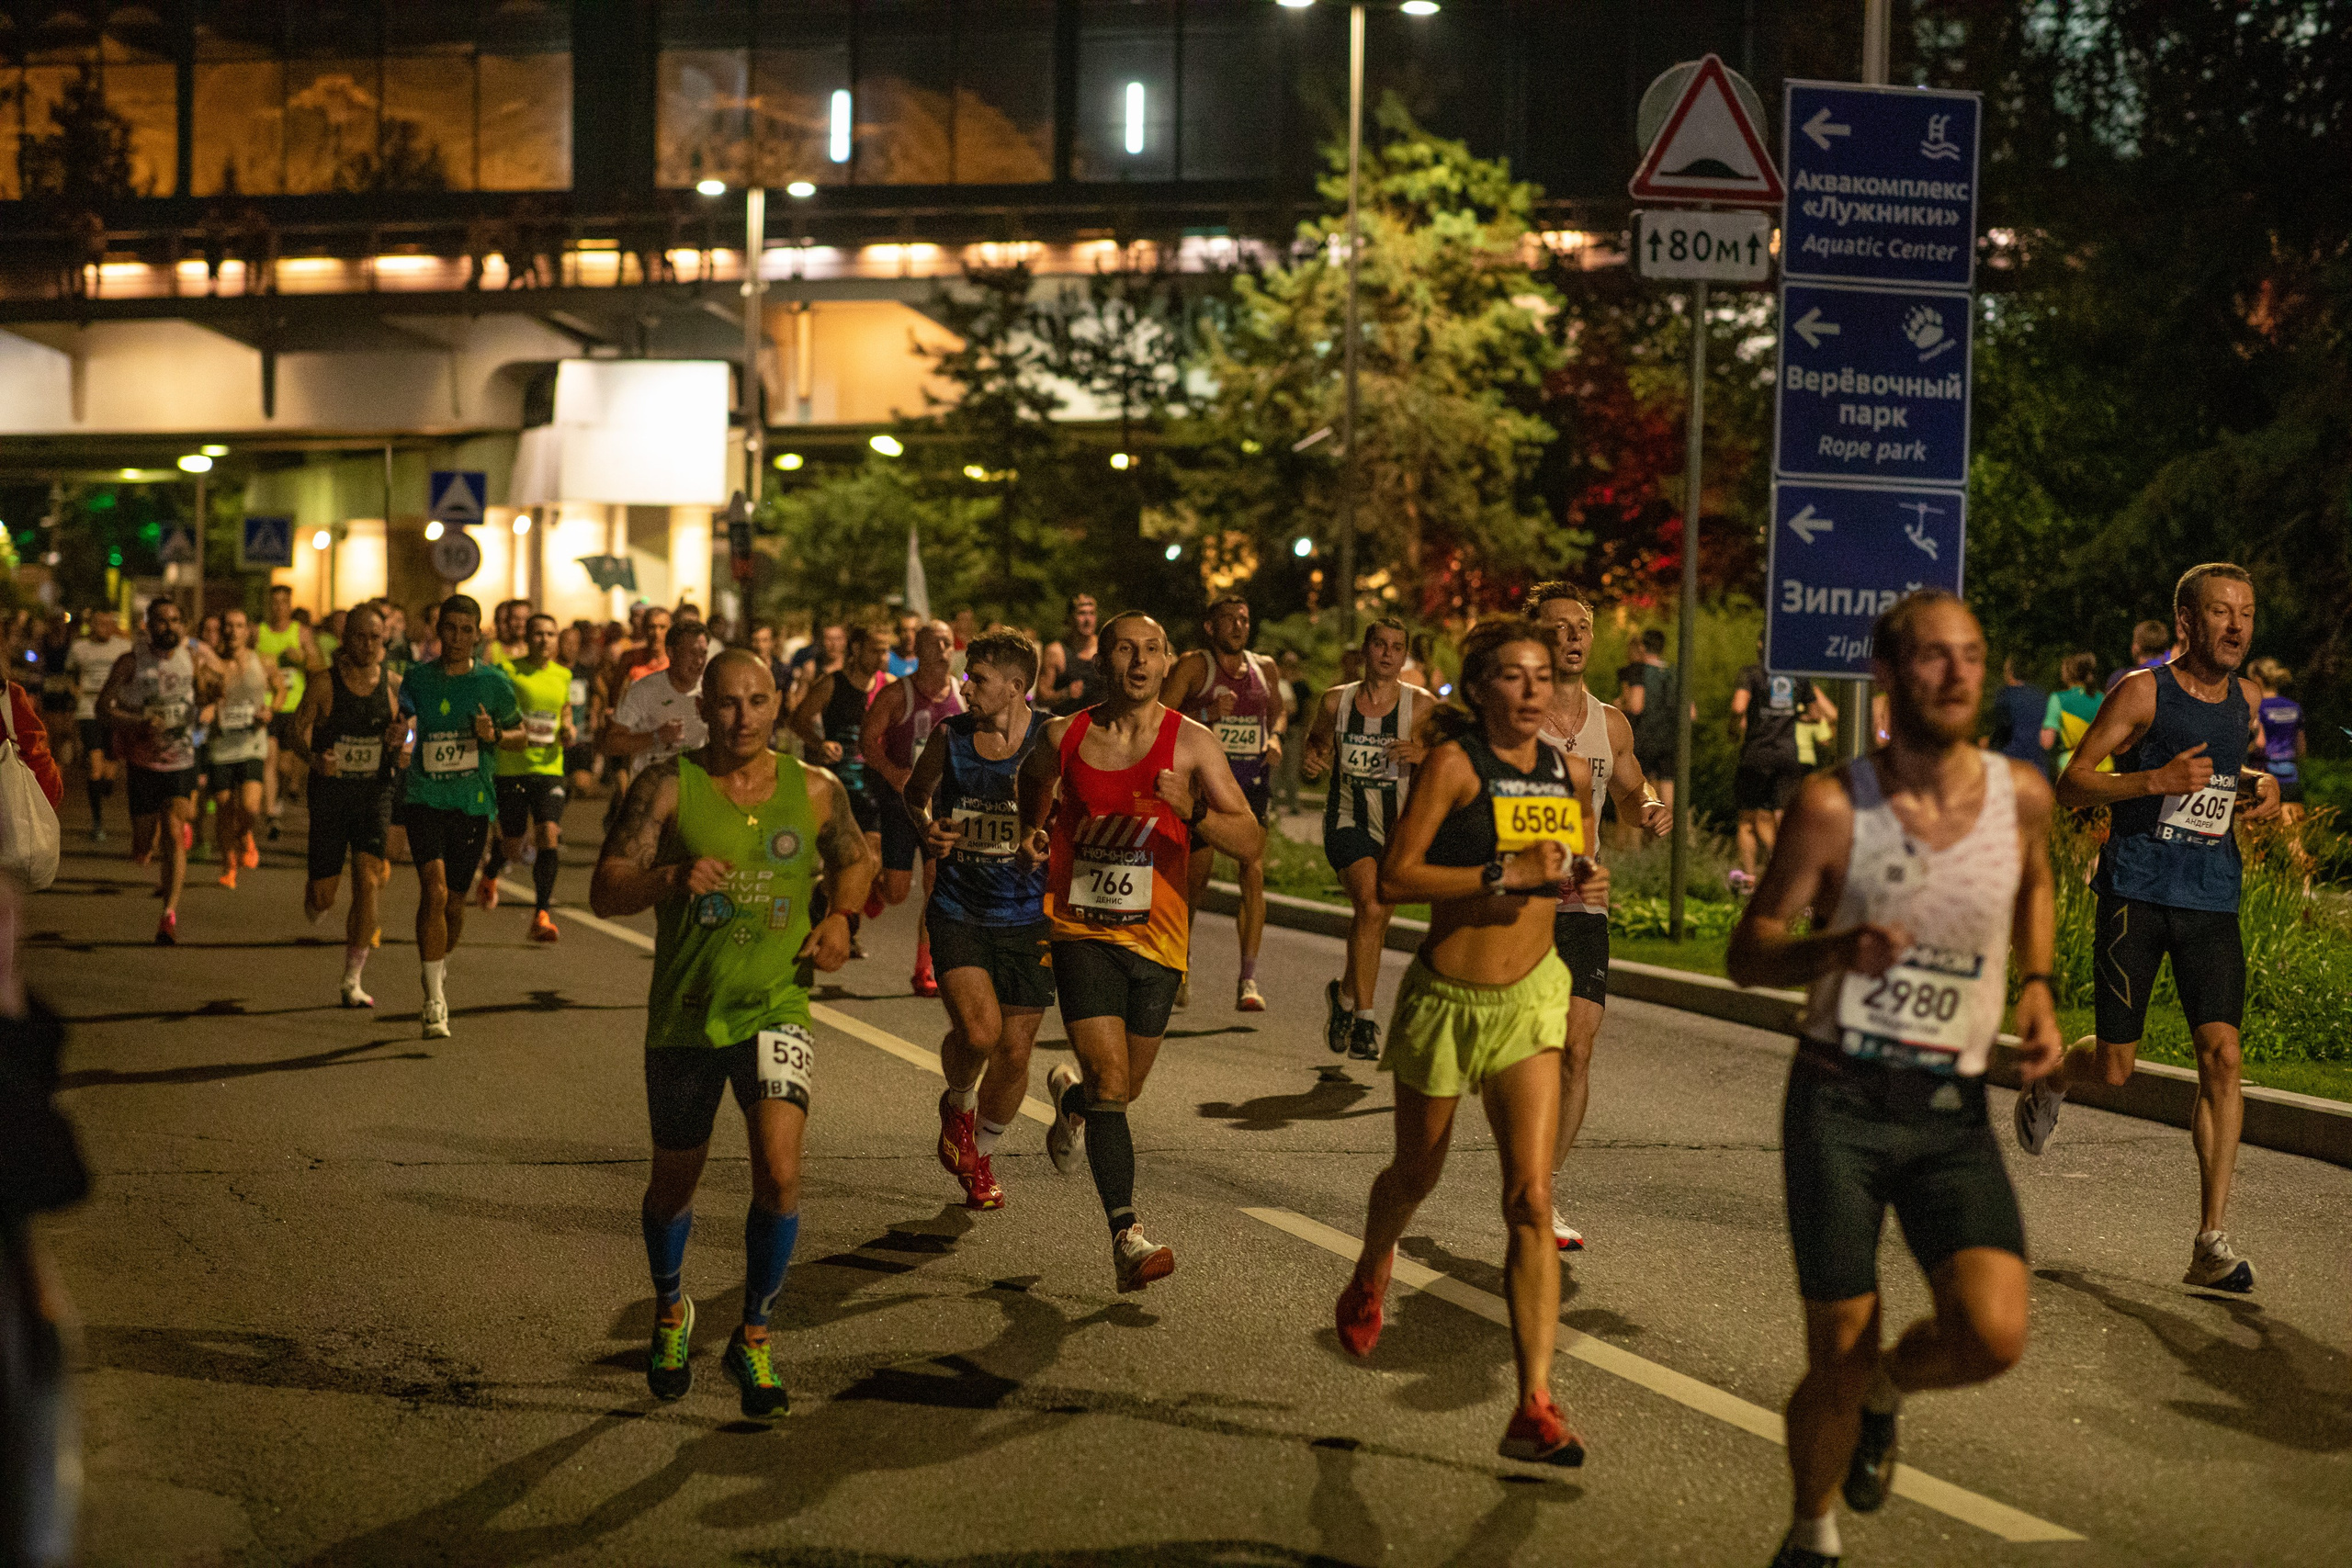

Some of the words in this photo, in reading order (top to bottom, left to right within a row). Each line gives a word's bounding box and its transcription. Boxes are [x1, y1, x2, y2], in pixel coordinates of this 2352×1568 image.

[1794, 169, 1970, 201] Аквакомплекс
[1802, 195, 1960, 227] «Лужники»
[1801, 232, 1883, 258] Aquatic
[1887, 238, 1959, 262] Center
[1786, 365, 1962, 400] Верёвочный
[1839, 404, 1907, 432] парк
[1818, 434, 1872, 462] Rope
[1875, 439, 1928, 464] park
[1781, 579, 1923, 616] Зипла
[1220, 728, 1256, 744] 7248
[435, 745, 466, 762] 697
[1348, 750, 1389, 769] 4161
[962, 817, 1014, 841] 1115
[1512, 805, 1575, 834] 6584
[2186, 818, 2213, 829] АНДРЕЙ
[1091, 869, 1133, 896] 766
[1096, 896, 1123, 905] ДЕНИС
[1863, 976, 1960, 1022] 2980
